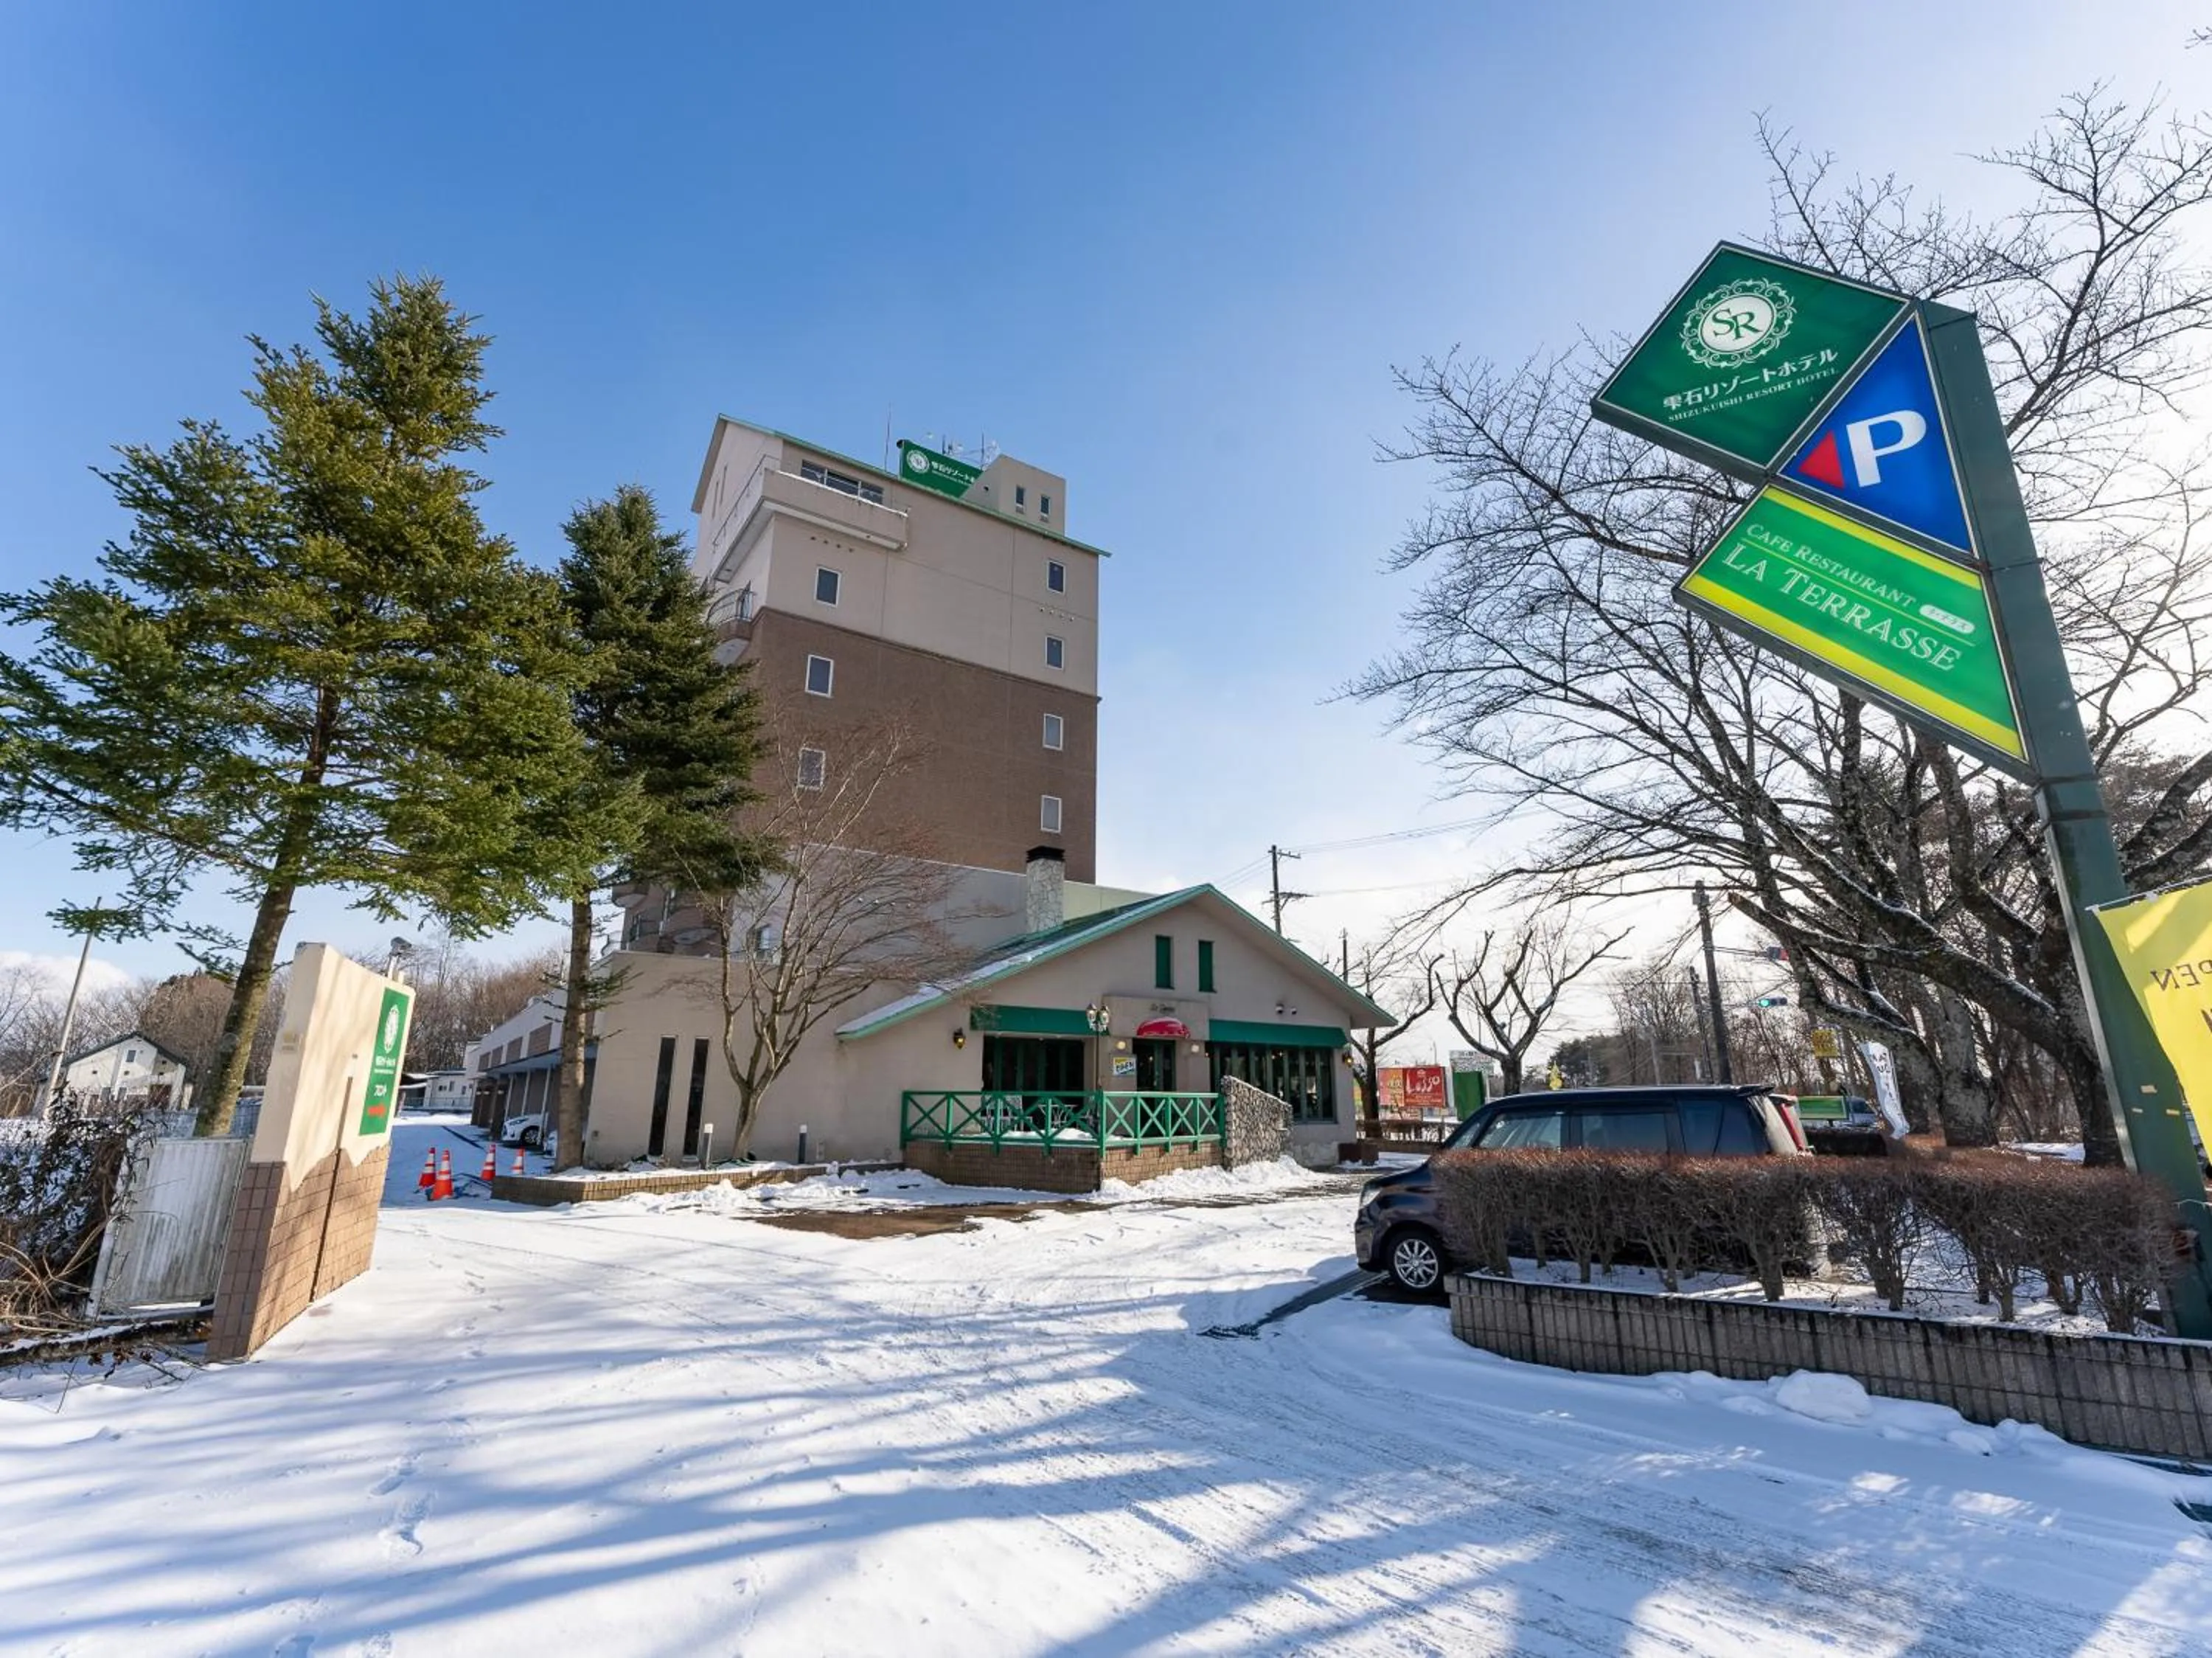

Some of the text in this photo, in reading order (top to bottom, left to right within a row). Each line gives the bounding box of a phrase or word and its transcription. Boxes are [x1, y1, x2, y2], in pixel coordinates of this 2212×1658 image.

[1711, 308, 1764, 341] SR
[1663, 348, 1838, 410] 雫石リゾートホテル
[1746, 380, 1794, 400] RESORT
[1797, 367, 1839, 386] HOTEL
[1846, 410, 1927, 488] P
[1746, 524, 1916, 608] CAFE RESTAURANT
[1722, 543, 1962, 670] LA TERRASSE
